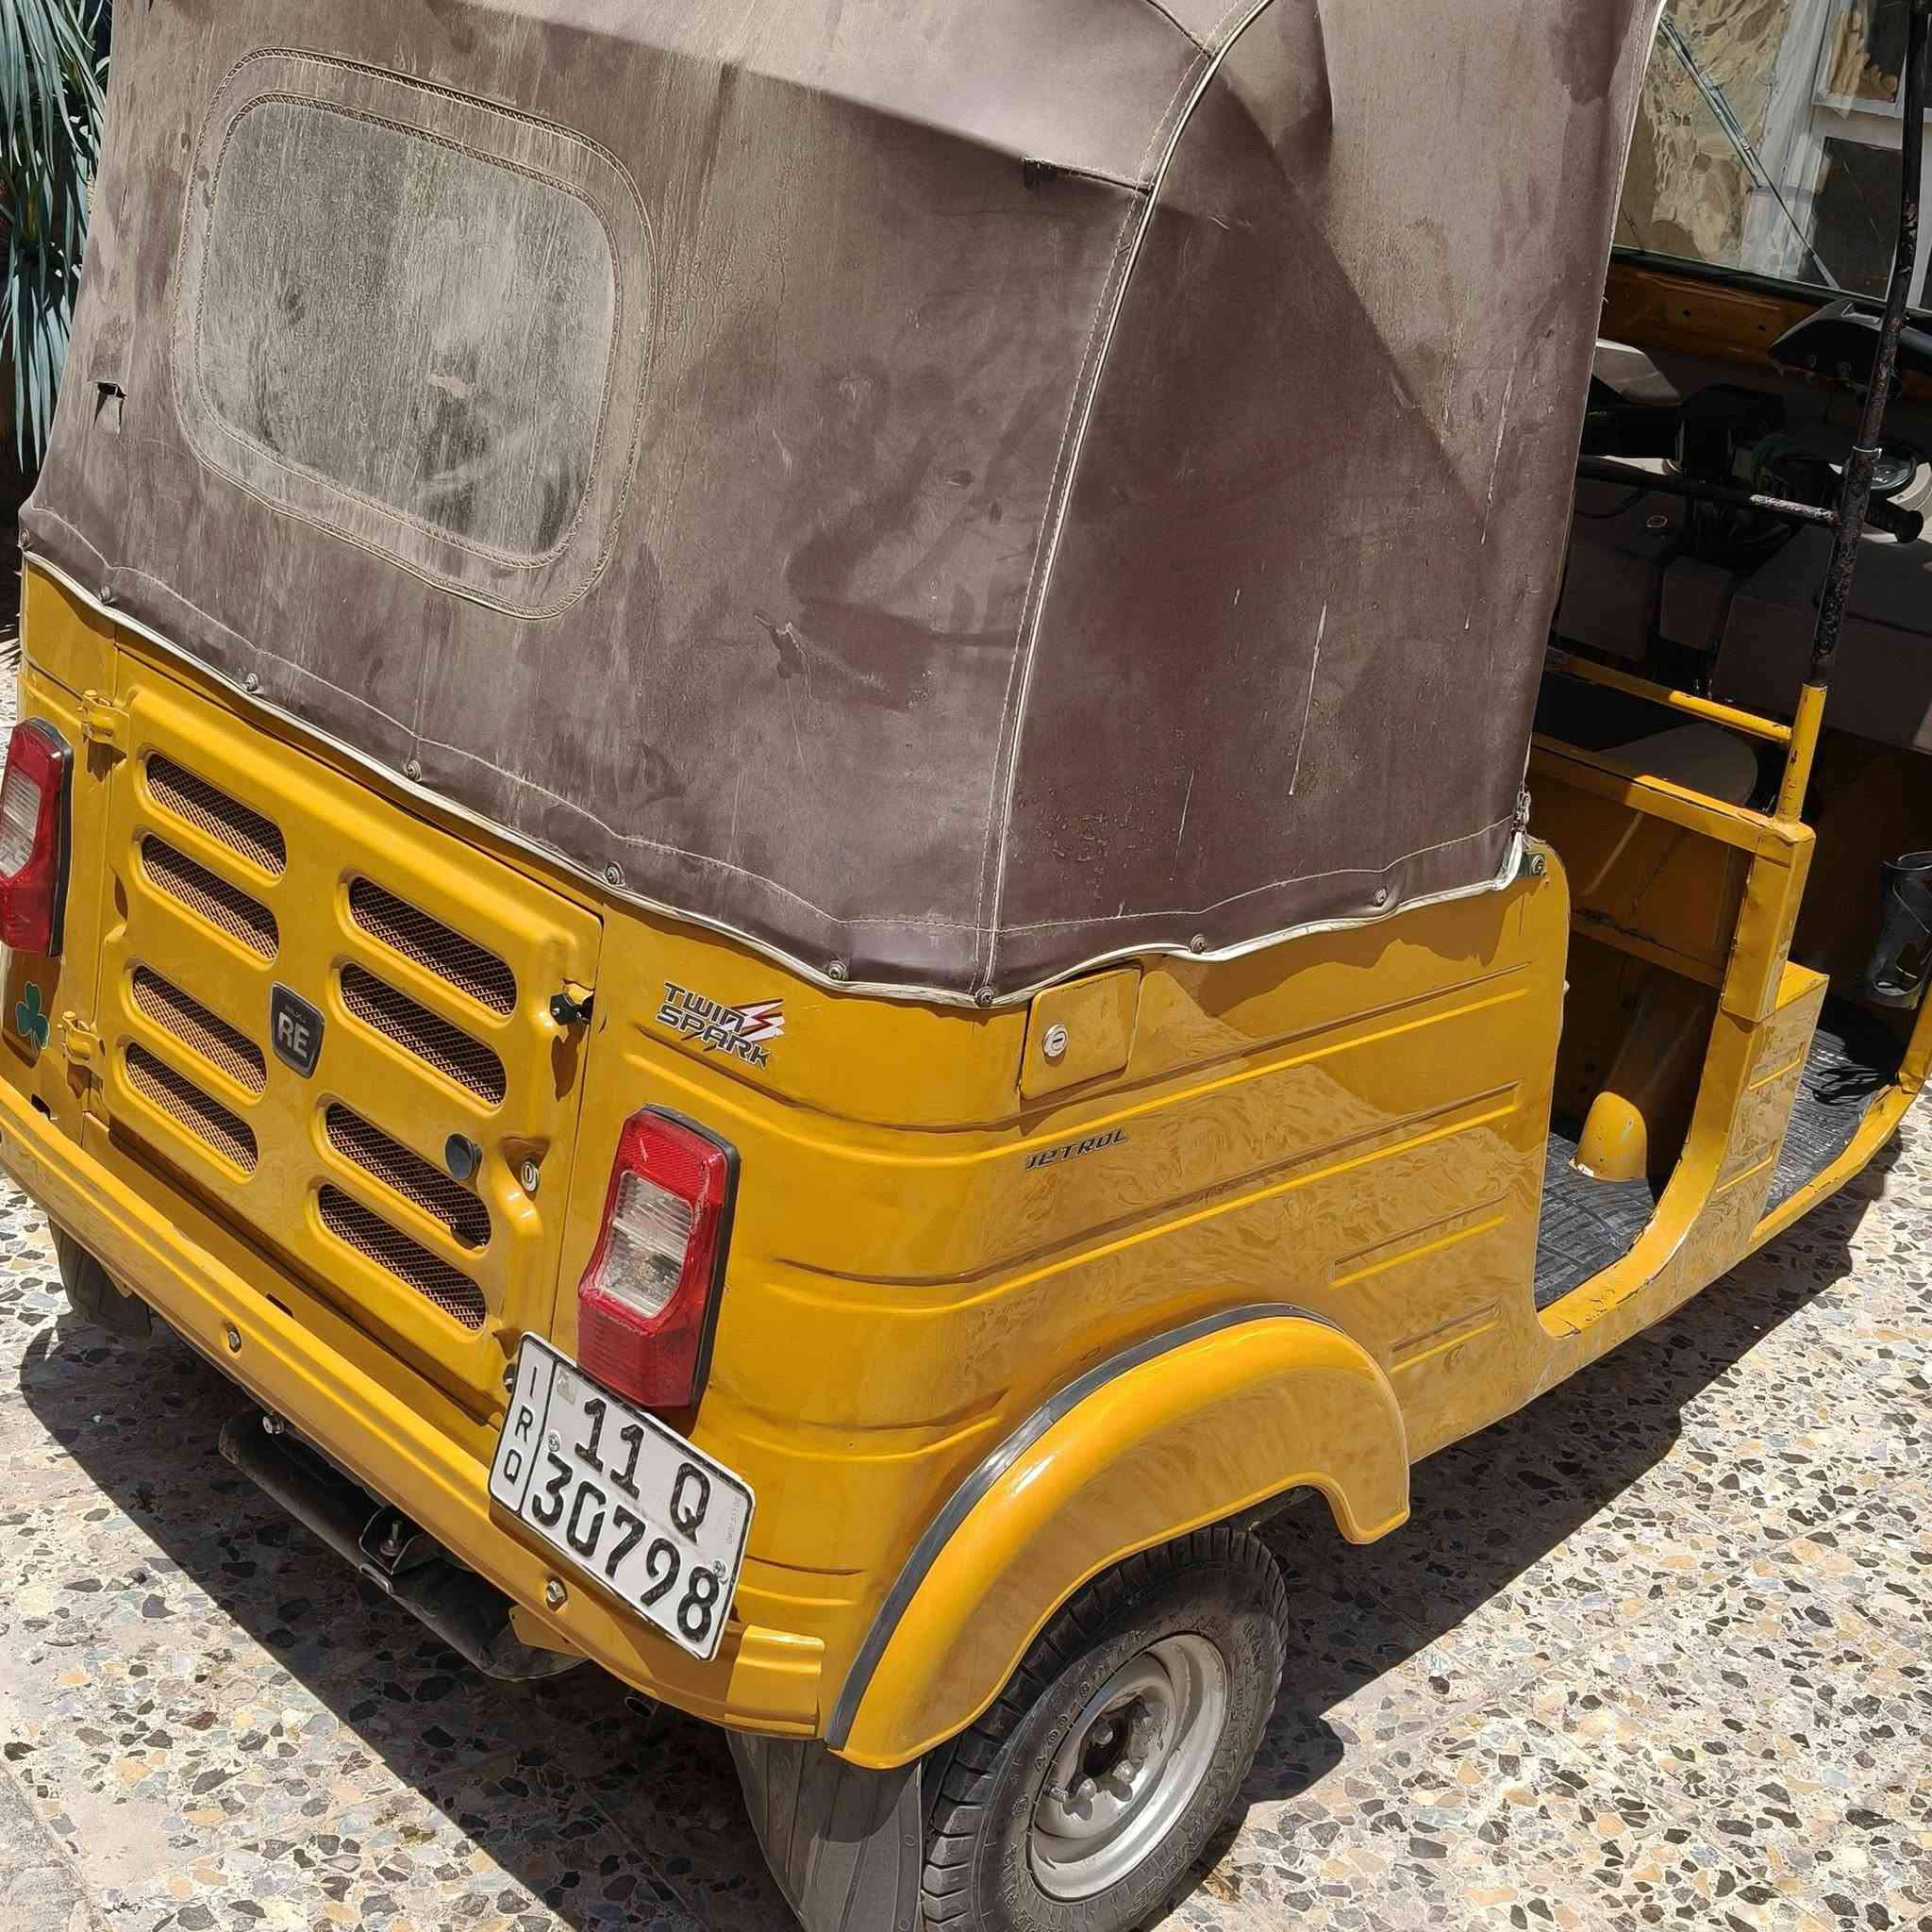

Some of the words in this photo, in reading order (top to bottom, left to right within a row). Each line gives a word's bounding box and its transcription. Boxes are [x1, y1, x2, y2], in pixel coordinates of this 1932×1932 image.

[277, 1011, 310, 1059] RE
[656, 1004, 771, 1071] SPARK
[504, 1366, 537, 1486] IRQ
[574, 1397, 645, 1500] 11
[669, 1461, 711, 1547] Q
[530, 1451, 720, 1643] 30798
